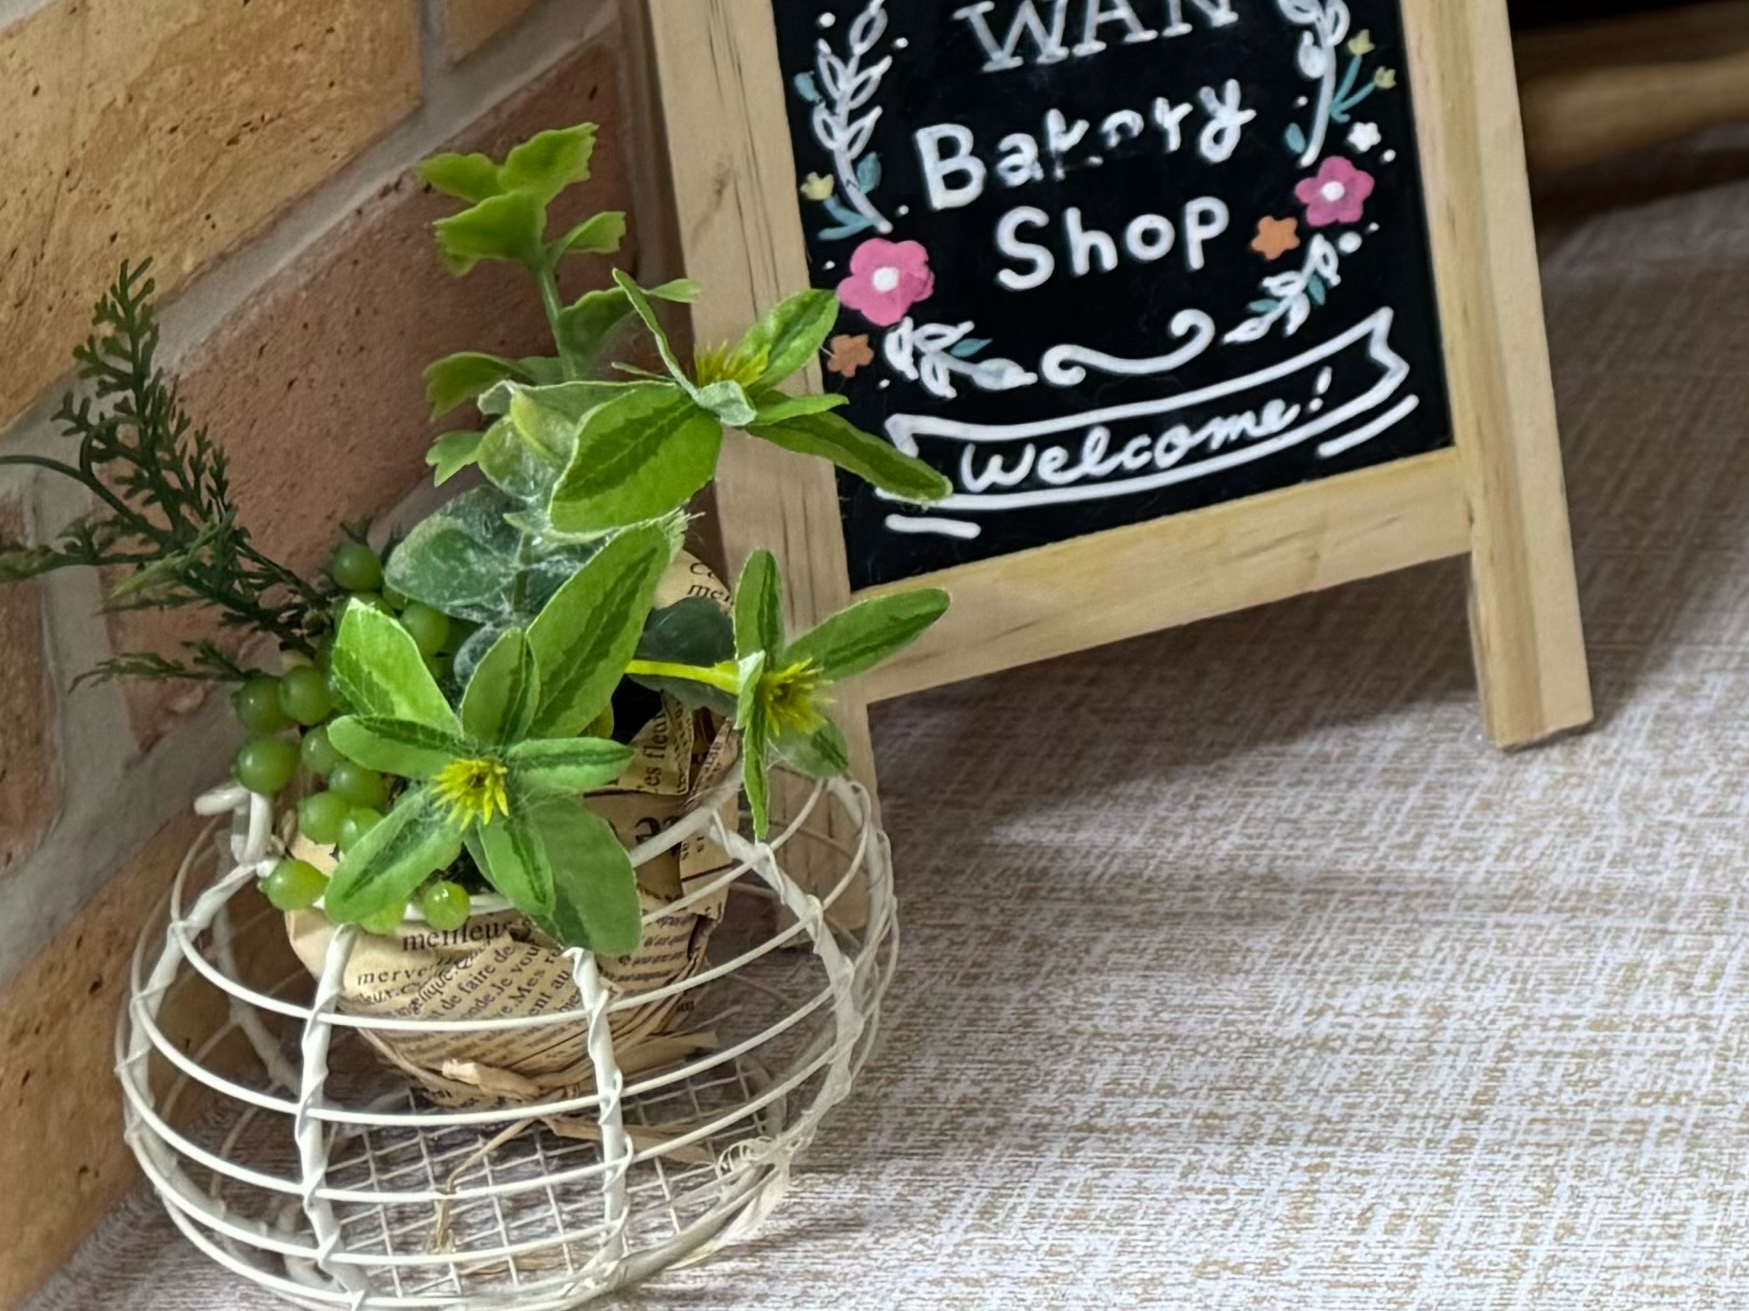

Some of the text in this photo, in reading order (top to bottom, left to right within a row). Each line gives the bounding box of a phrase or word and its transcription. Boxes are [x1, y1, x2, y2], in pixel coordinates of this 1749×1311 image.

[995, 196, 1230, 291] Shop
[457, 962, 496, 995] faire
[497, 944, 515, 963] de
